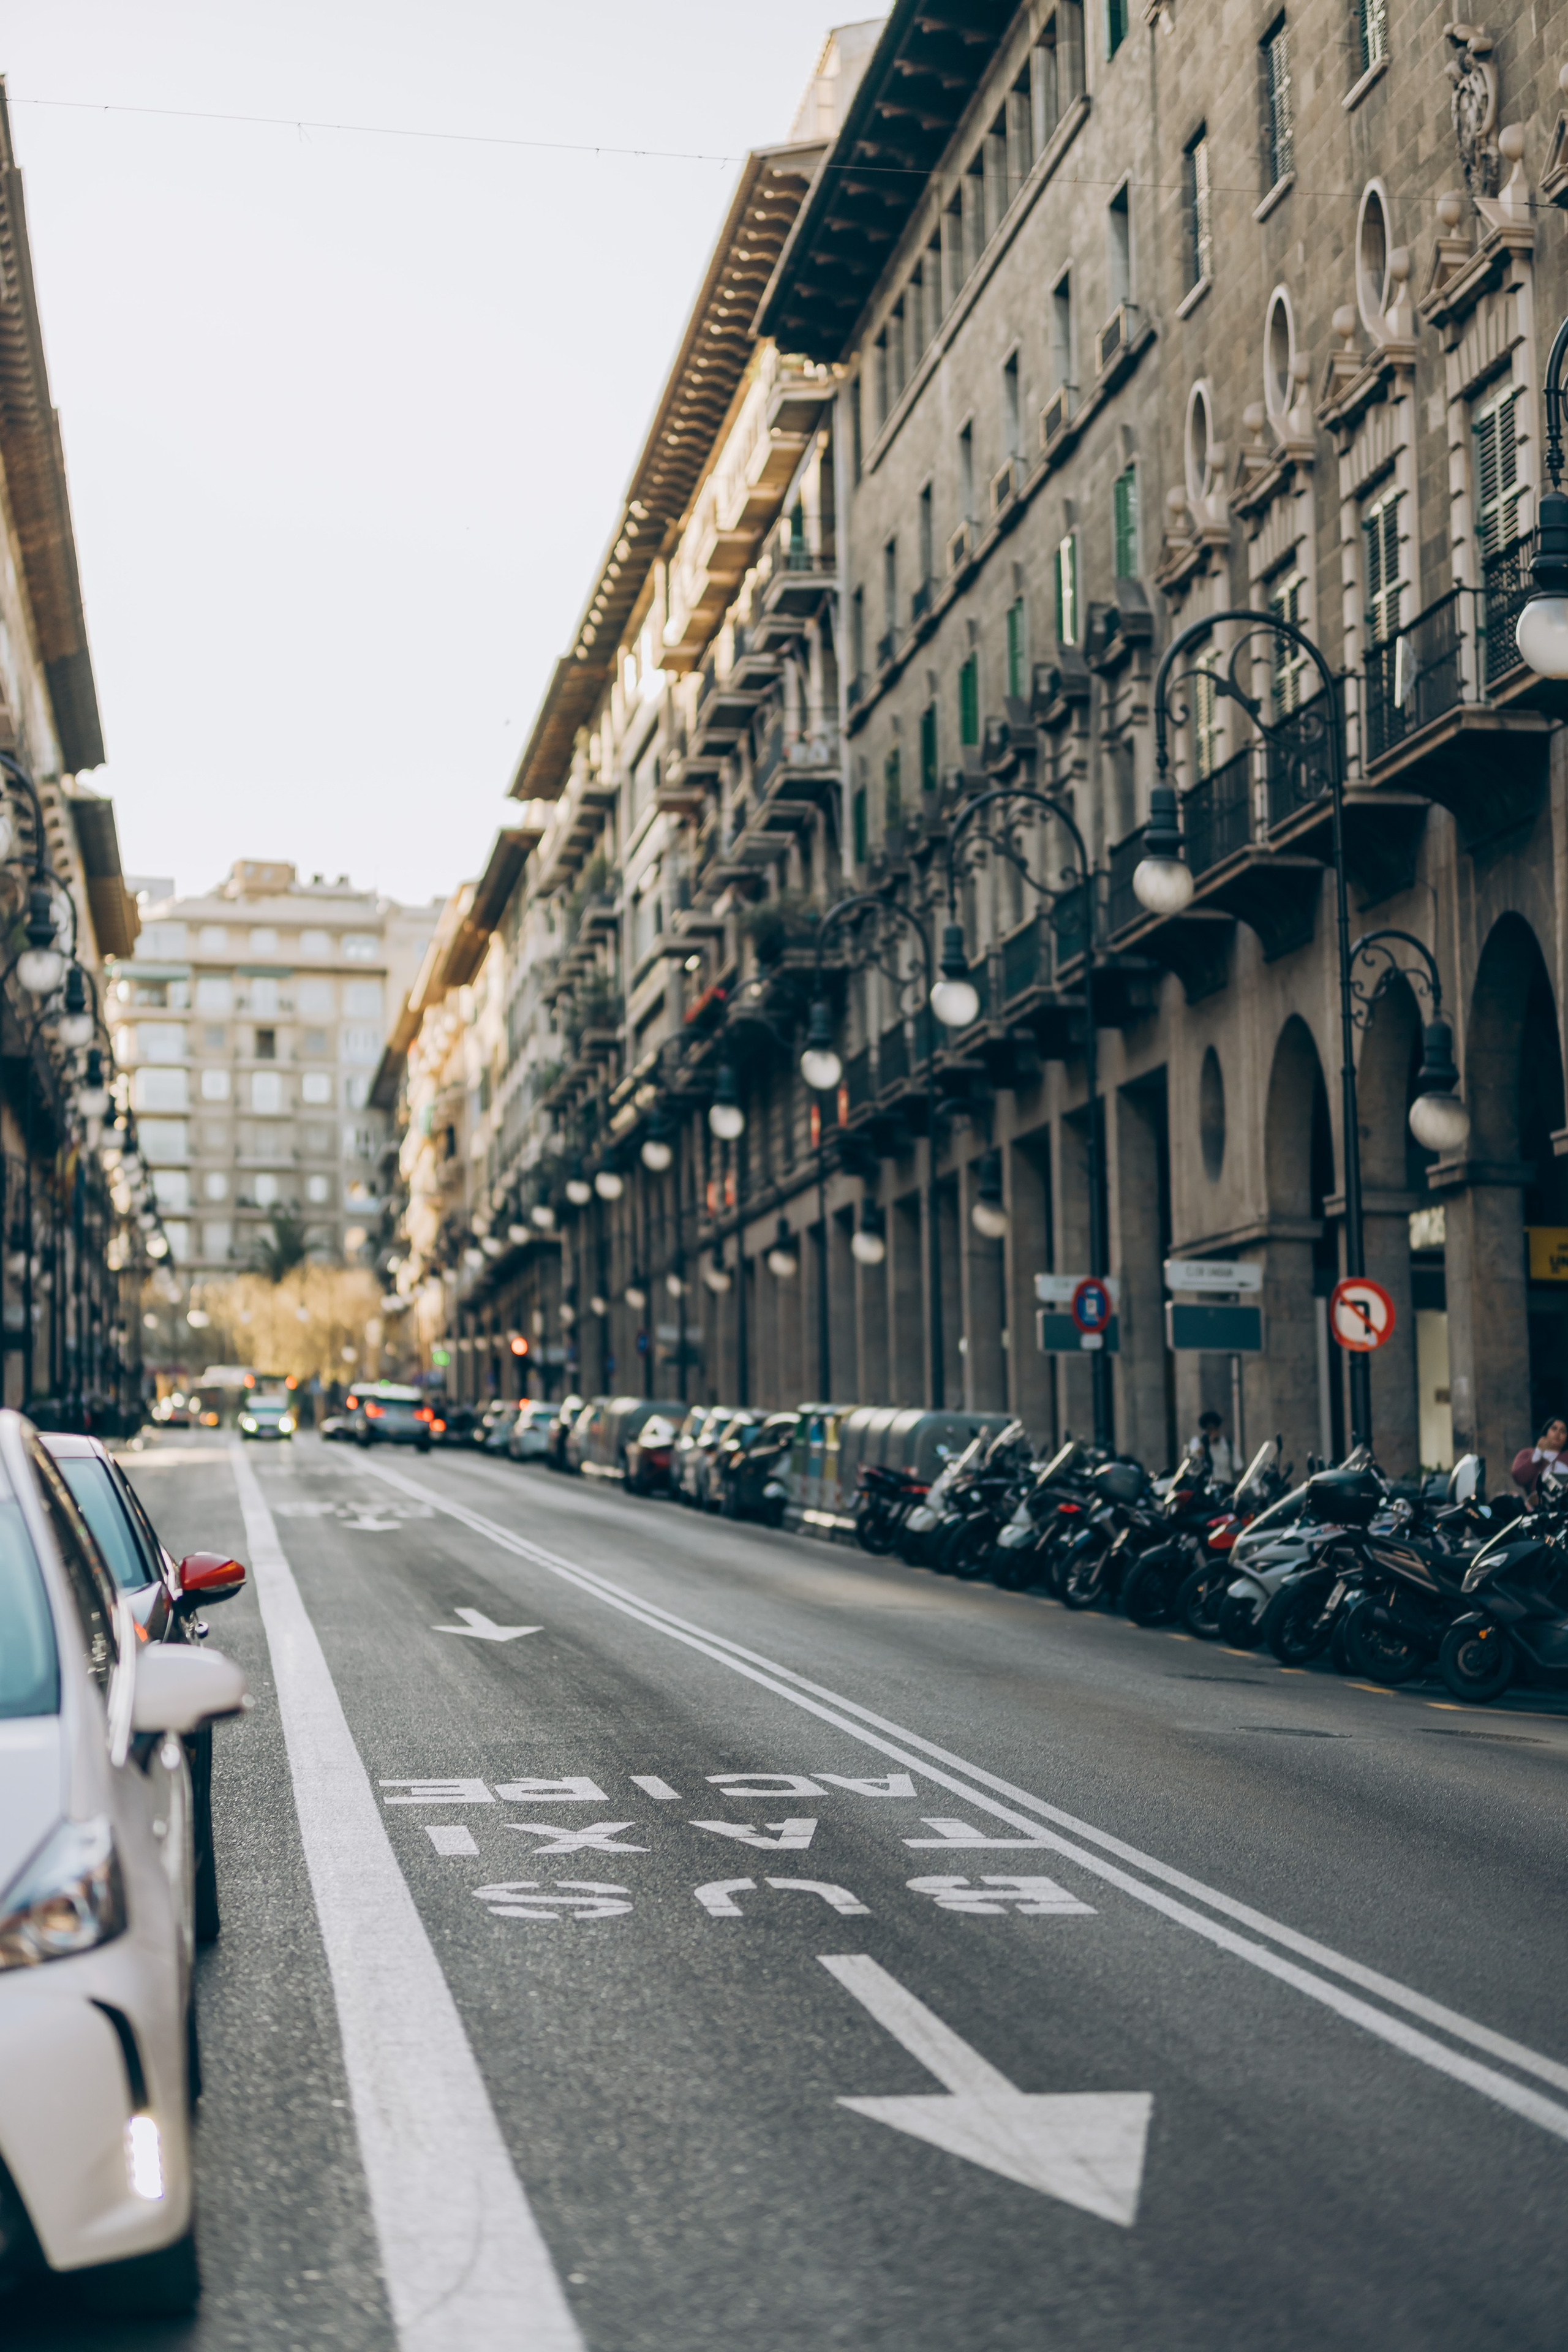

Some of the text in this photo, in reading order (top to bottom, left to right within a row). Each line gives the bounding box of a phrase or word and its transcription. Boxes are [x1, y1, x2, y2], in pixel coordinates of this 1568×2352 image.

[378, 1774, 918, 1804] ACIRE
[424, 1818, 1049, 1855] TAXI
[471, 1875, 1099, 1919] BUS
